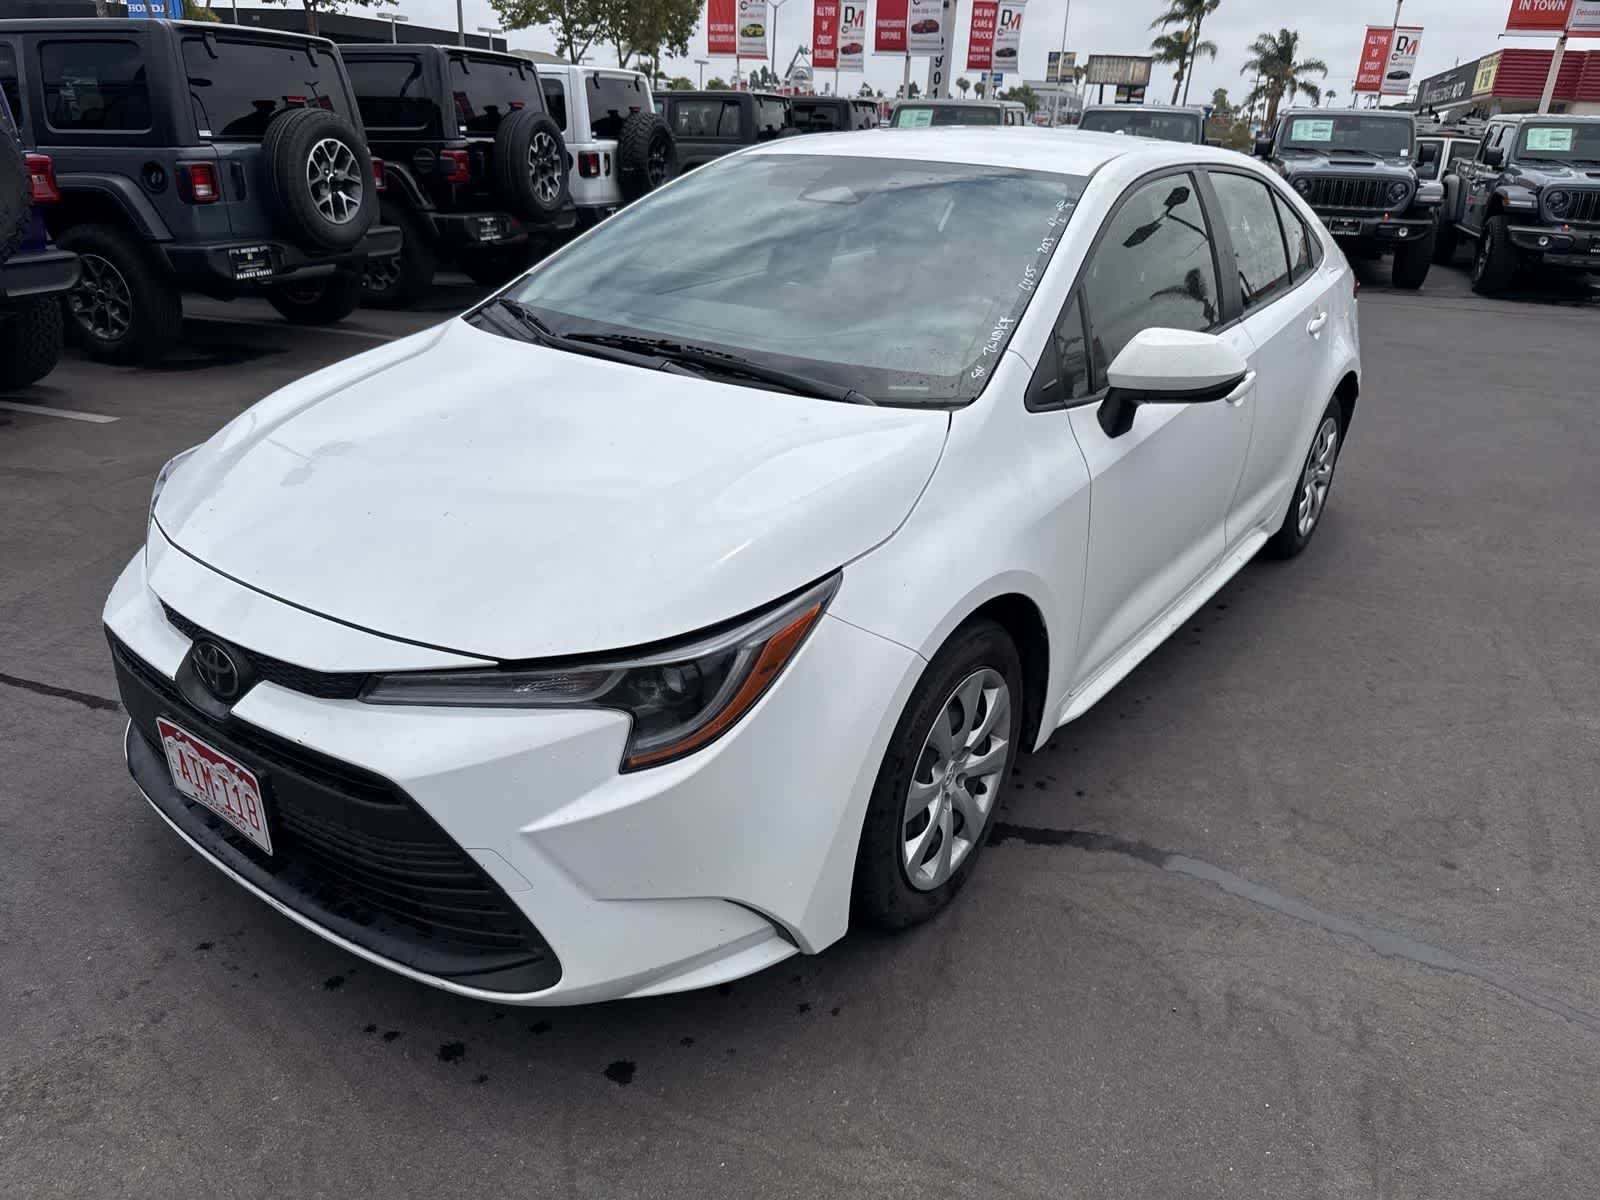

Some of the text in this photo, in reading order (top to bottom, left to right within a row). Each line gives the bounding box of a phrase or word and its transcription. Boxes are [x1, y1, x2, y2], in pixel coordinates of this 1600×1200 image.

[1519, 0, 1567, 11] IN TOWN
[984, 8, 995, 17] BUY
[973, 19, 988, 28] CARS
[971, 31, 993, 39] TRUCKS
[1378, 35, 1389, 45] TYPE
